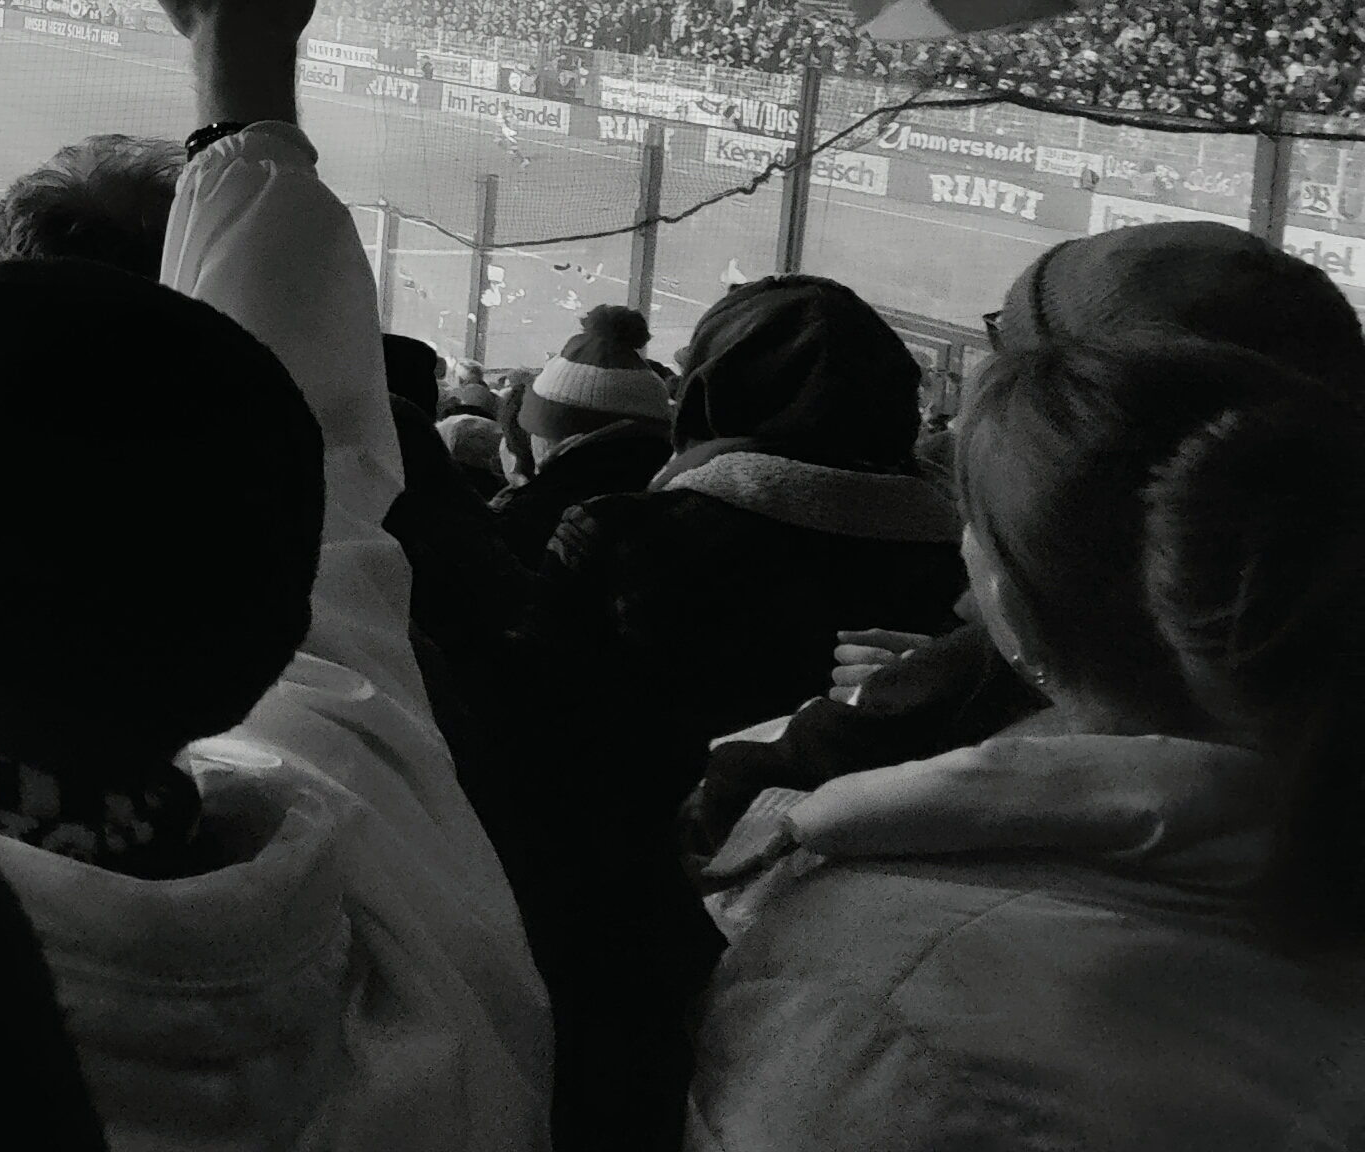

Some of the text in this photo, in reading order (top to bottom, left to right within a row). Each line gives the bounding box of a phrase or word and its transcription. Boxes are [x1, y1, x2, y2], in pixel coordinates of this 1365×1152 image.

[448, 90, 467, 111] Im
[877, 121, 1035, 164] Ummerstadt
[929, 174, 1044, 221] RINTI
